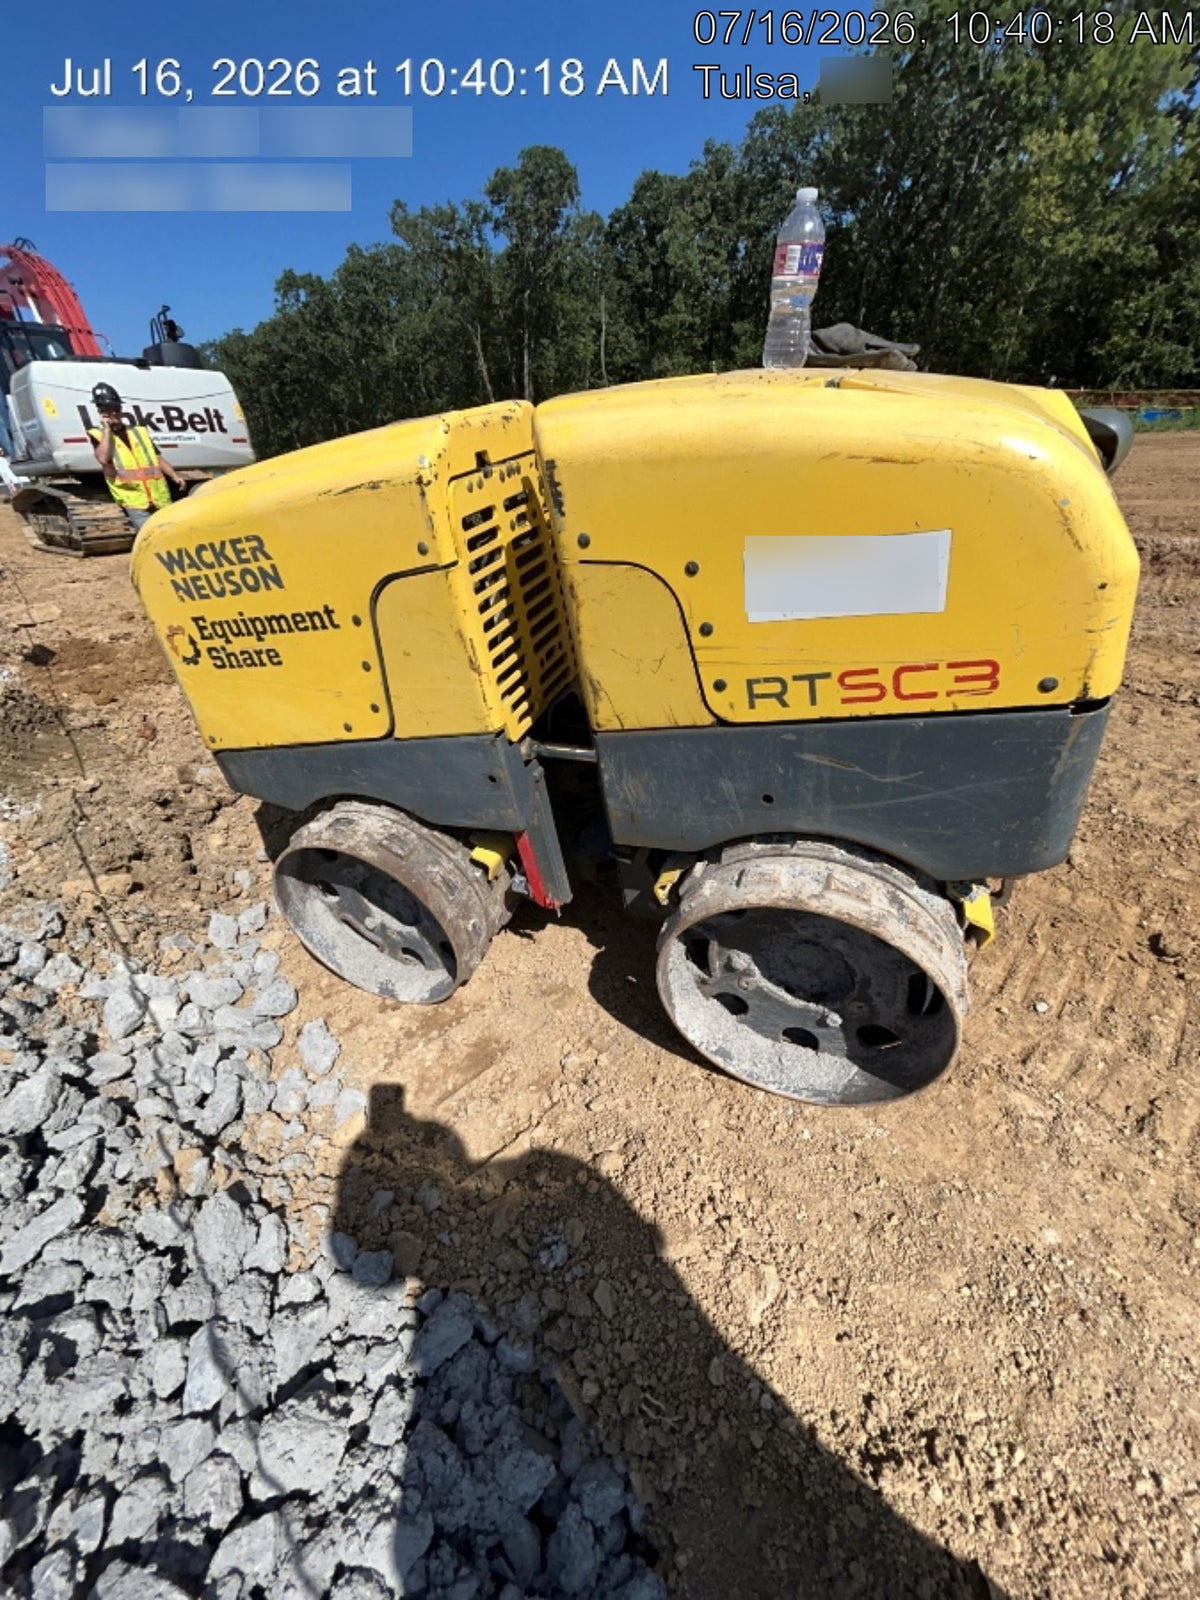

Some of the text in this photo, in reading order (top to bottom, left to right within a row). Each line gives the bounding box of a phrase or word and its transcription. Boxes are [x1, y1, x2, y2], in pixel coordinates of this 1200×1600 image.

[155, 534, 274, 576] WACKER
[170, 563, 285, 603] NEUSON
[190, 604, 341, 644] Equipment
[206, 646, 283, 670] Share
